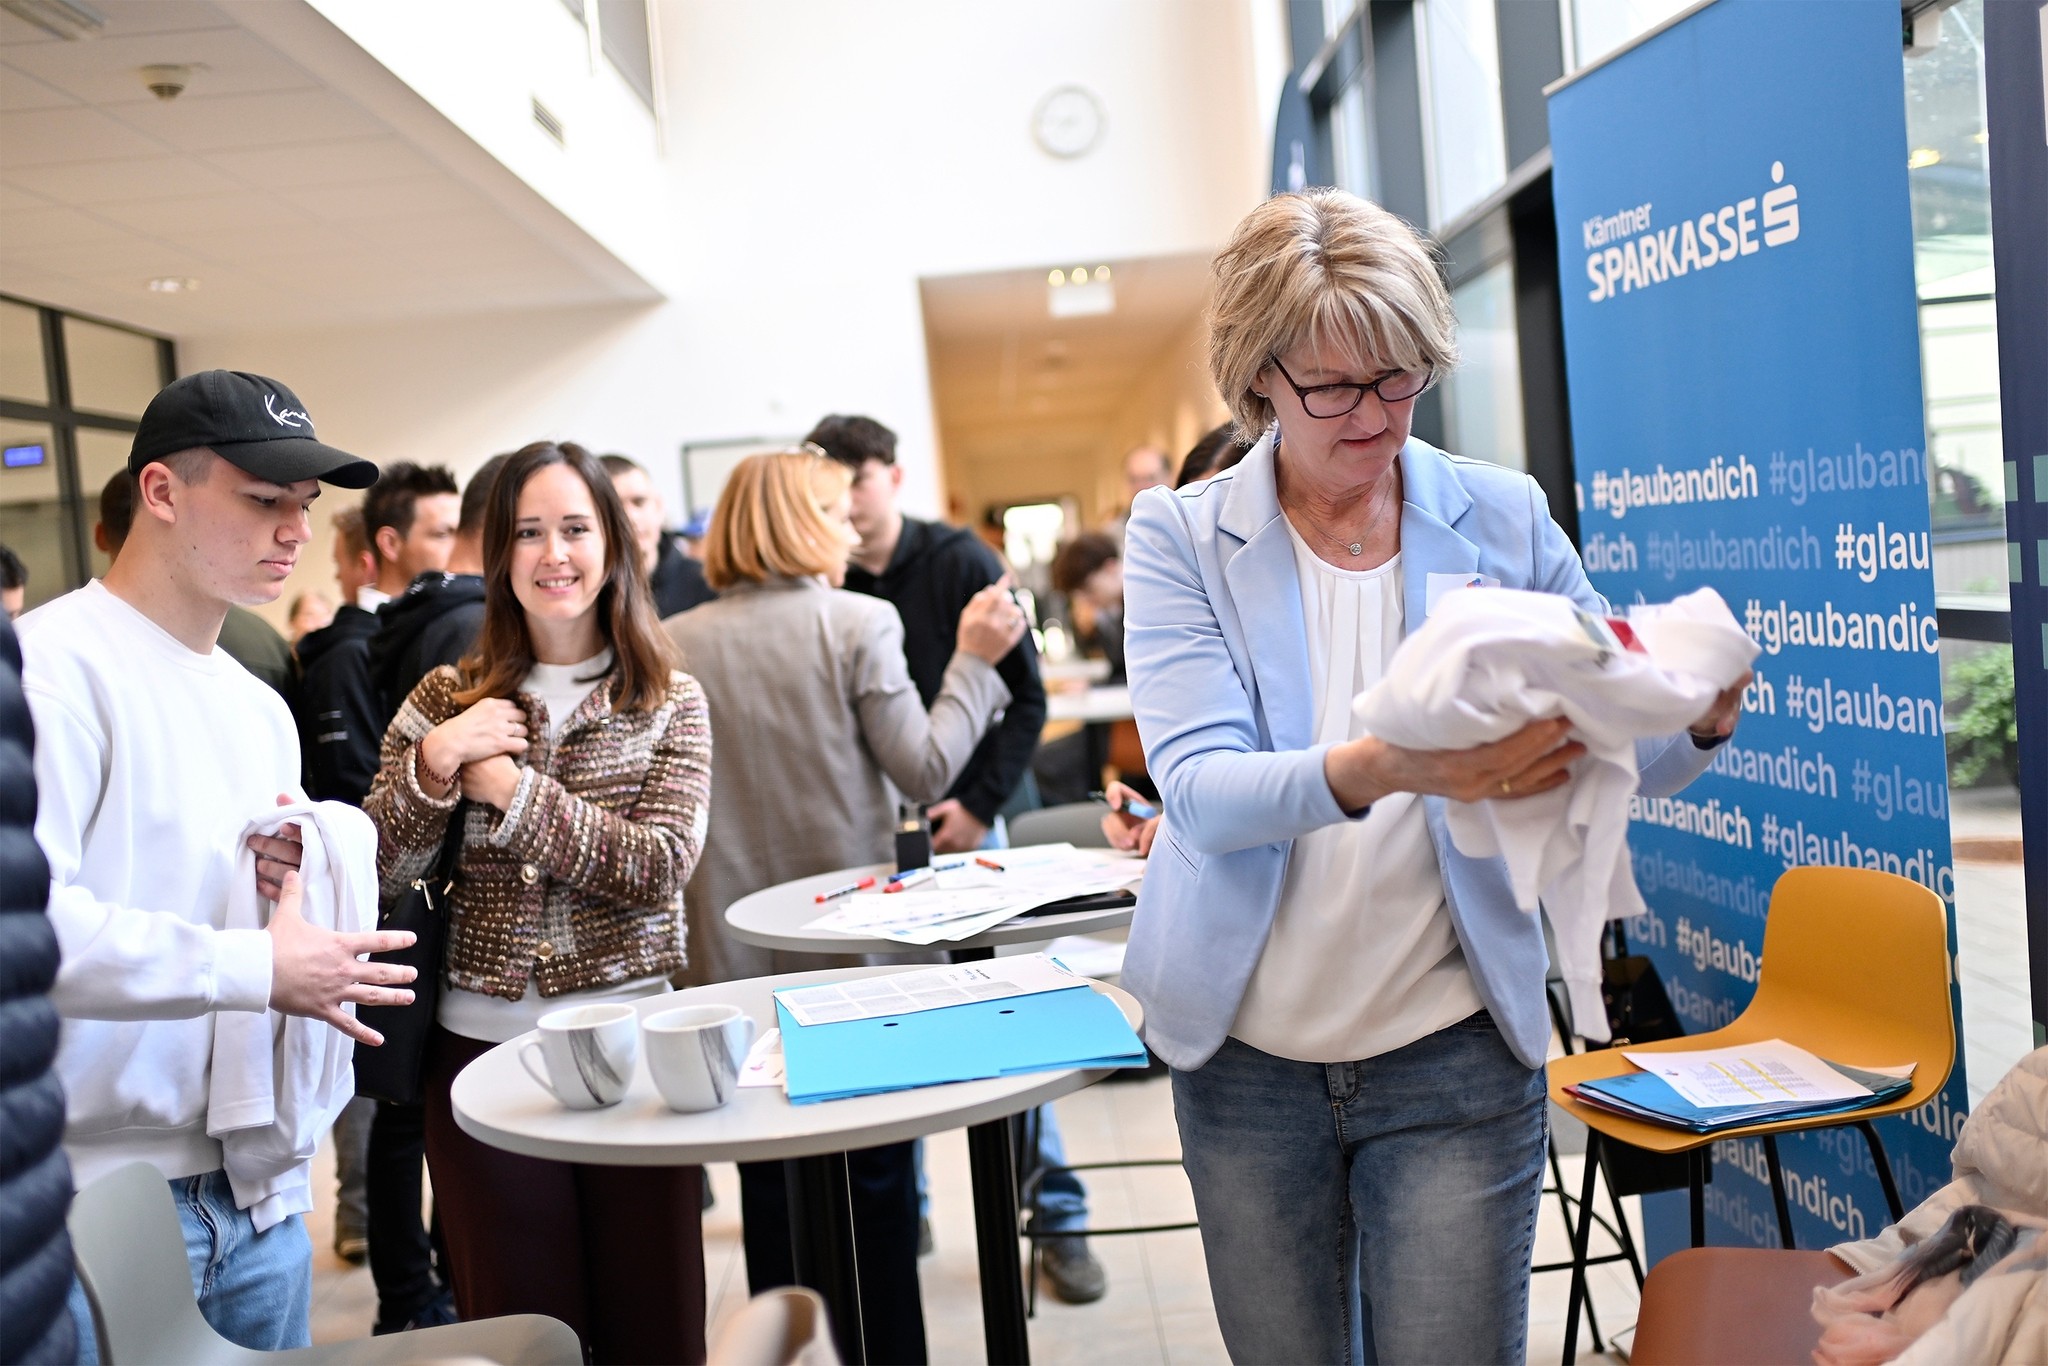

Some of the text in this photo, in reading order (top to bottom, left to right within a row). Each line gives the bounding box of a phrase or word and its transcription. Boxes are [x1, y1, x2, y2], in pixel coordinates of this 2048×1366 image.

[1582, 202, 1652, 250] Kärntner
[1586, 197, 1760, 303] SPARKASSE
[1592, 454, 1759, 520] #glaubandich
[1583, 521, 1931, 583] dich #glaubandich #glau
[1745, 598, 1939, 655] #glaubandic
[1704, 739, 1946, 821] ubandich #glau
